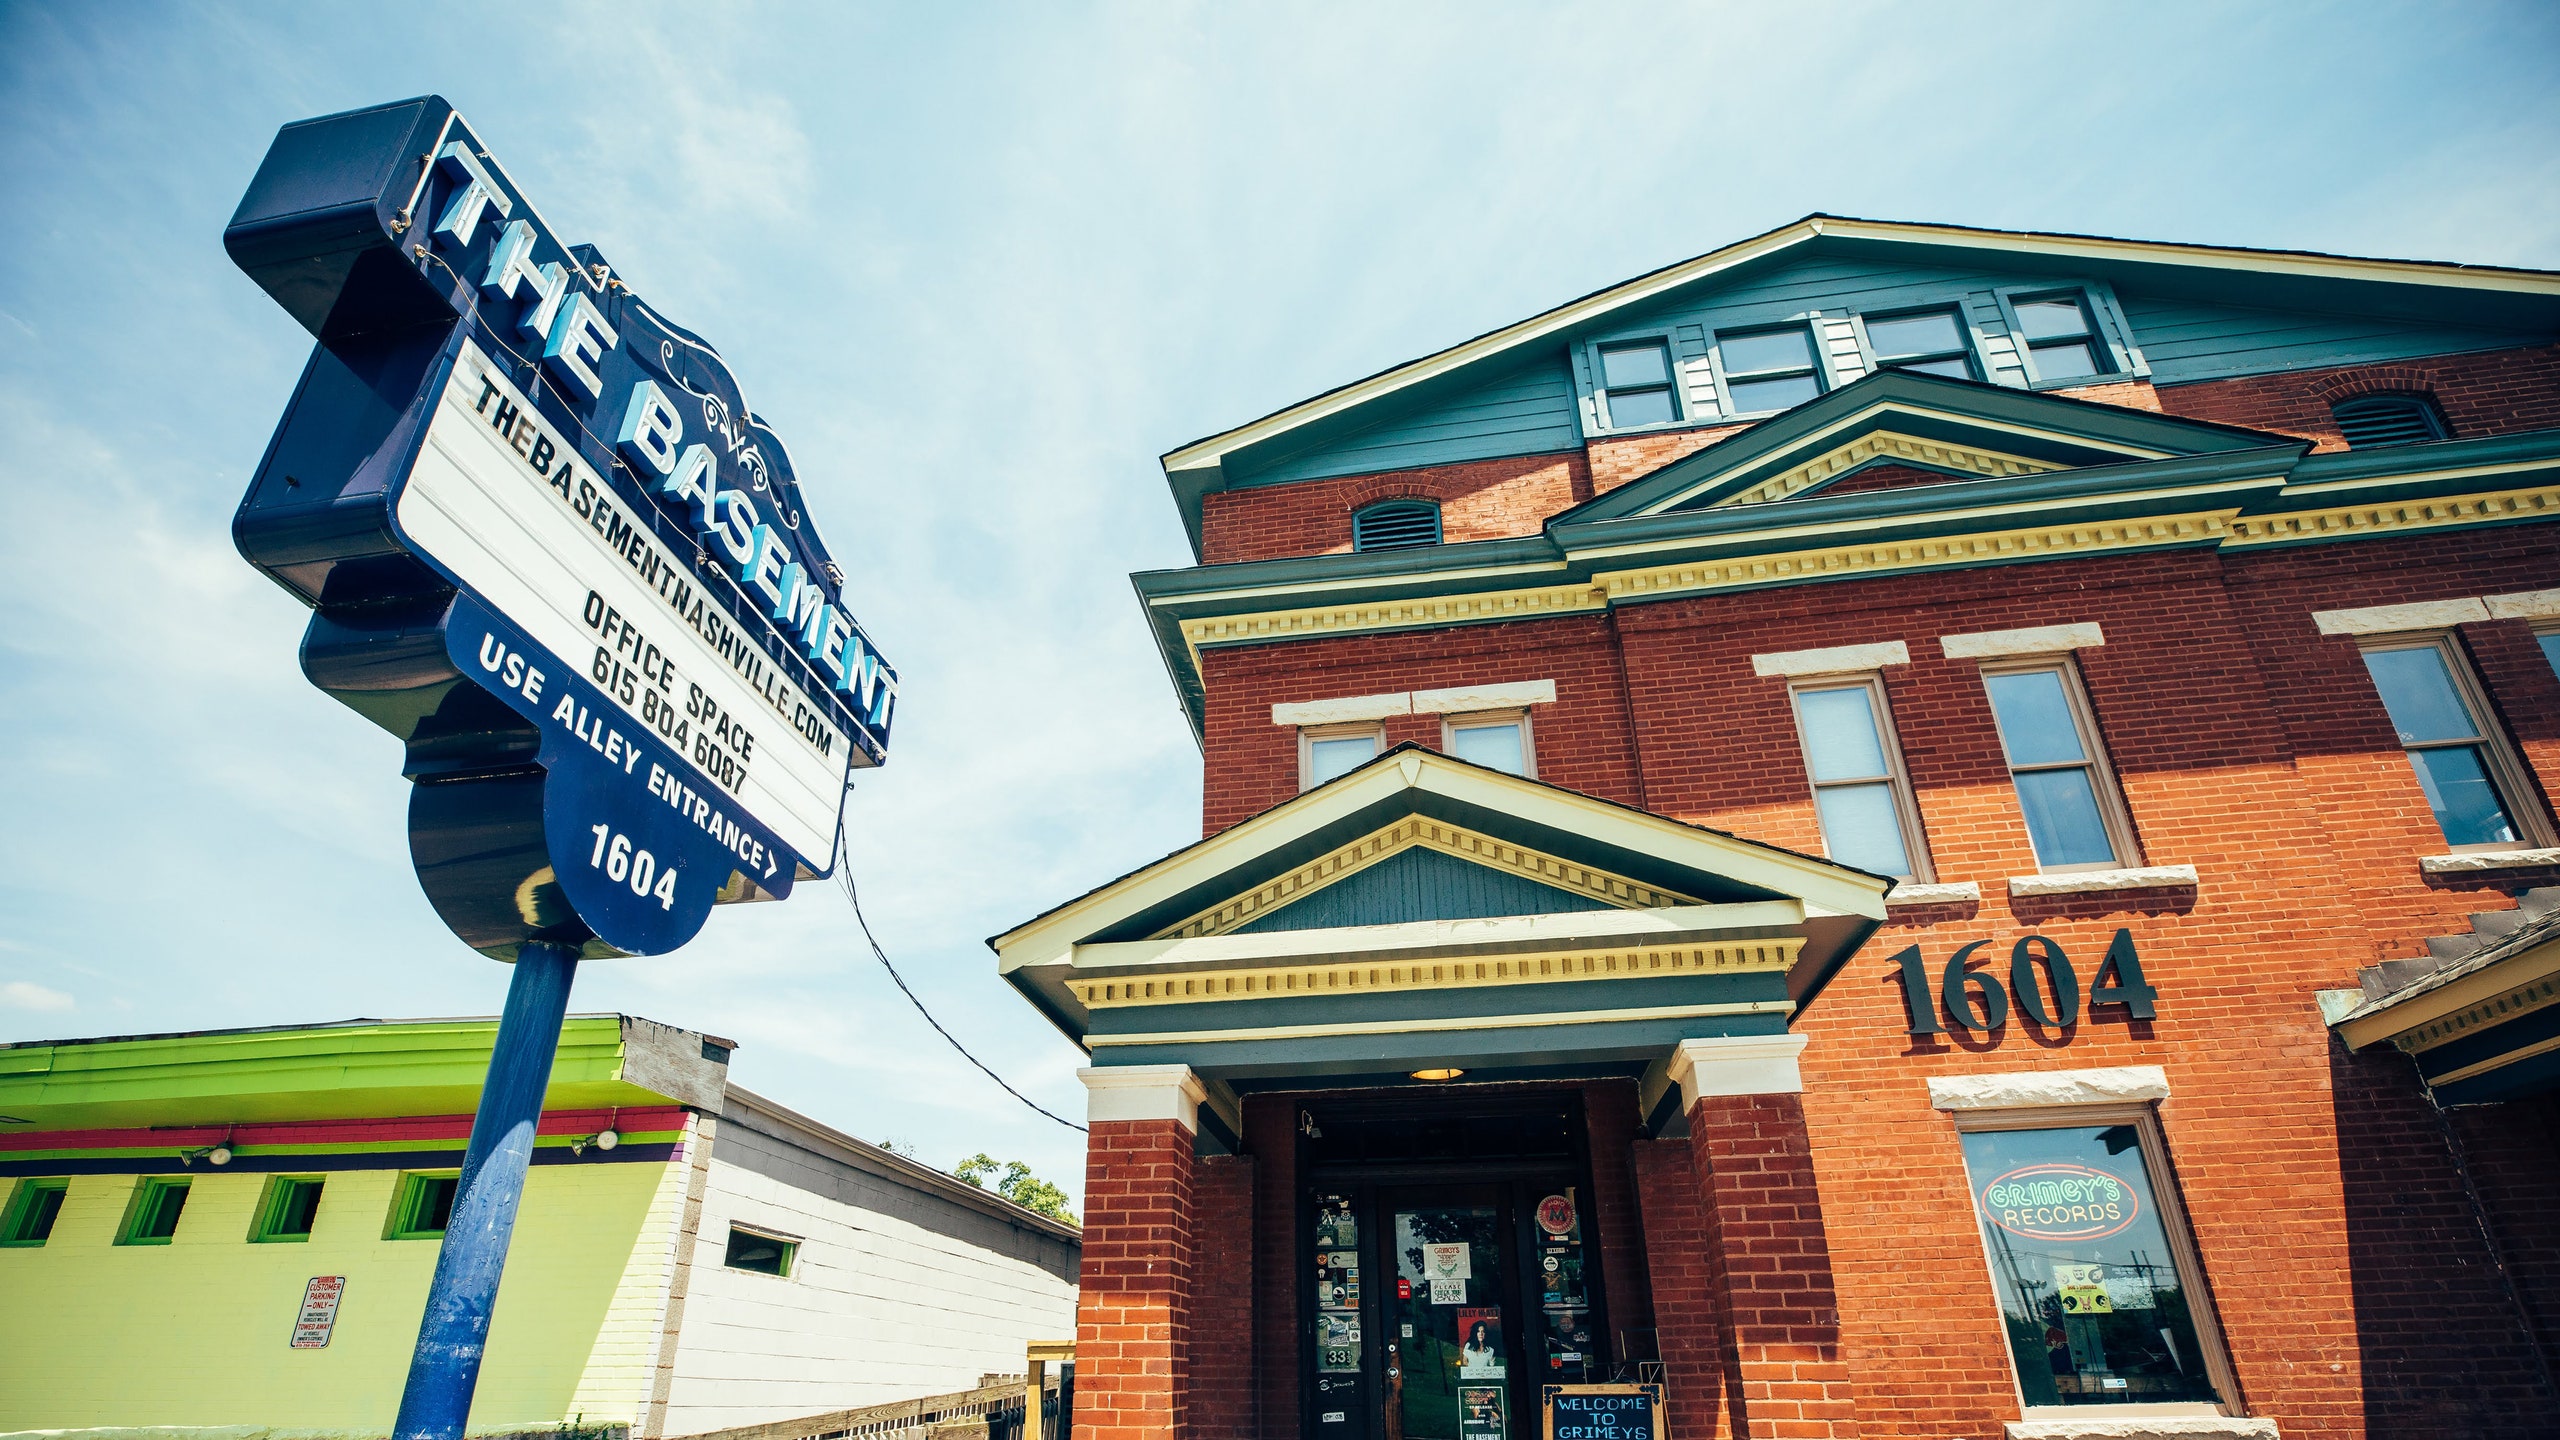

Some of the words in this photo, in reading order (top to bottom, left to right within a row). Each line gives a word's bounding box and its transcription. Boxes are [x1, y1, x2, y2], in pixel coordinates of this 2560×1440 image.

[433, 140, 619, 399] THE
[617, 380, 900, 731] BASEMENT
[475, 373, 833, 758] THEBASEMENTNASHVILLE.COM
[583, 588, 676, 695] OFFICE
[686, 681, 755, 763] SPACE
[591, 645, 639, 706] 615
[641, 687, 689, 751] 804
[693, 732, 747, 795] 6087
[479, 631, 546, 705] USE
[551, 693, 642, 775] ALLEY
[647, 762, 765, 870] ENTRANCE
[590, 823, 678, 912] 1604
[1884, 927, 2159, 1034] 1604
[1989, 1175, 2121, 1208] GRIMEY'S
[2003, 1202, 2121, 1227] RECORDS
[310, 1283, 341, 1291] CUSTOMER
[310, 1292, 336, 1300] PARKING
[312, 1301, 329, 1309] ONLY
[1557, 1397, 1646, 1411] WELCOME
[1588, 1413, 1616, 1425] TO
[1558, 1426, 1647, 1440] GRIMEYS
